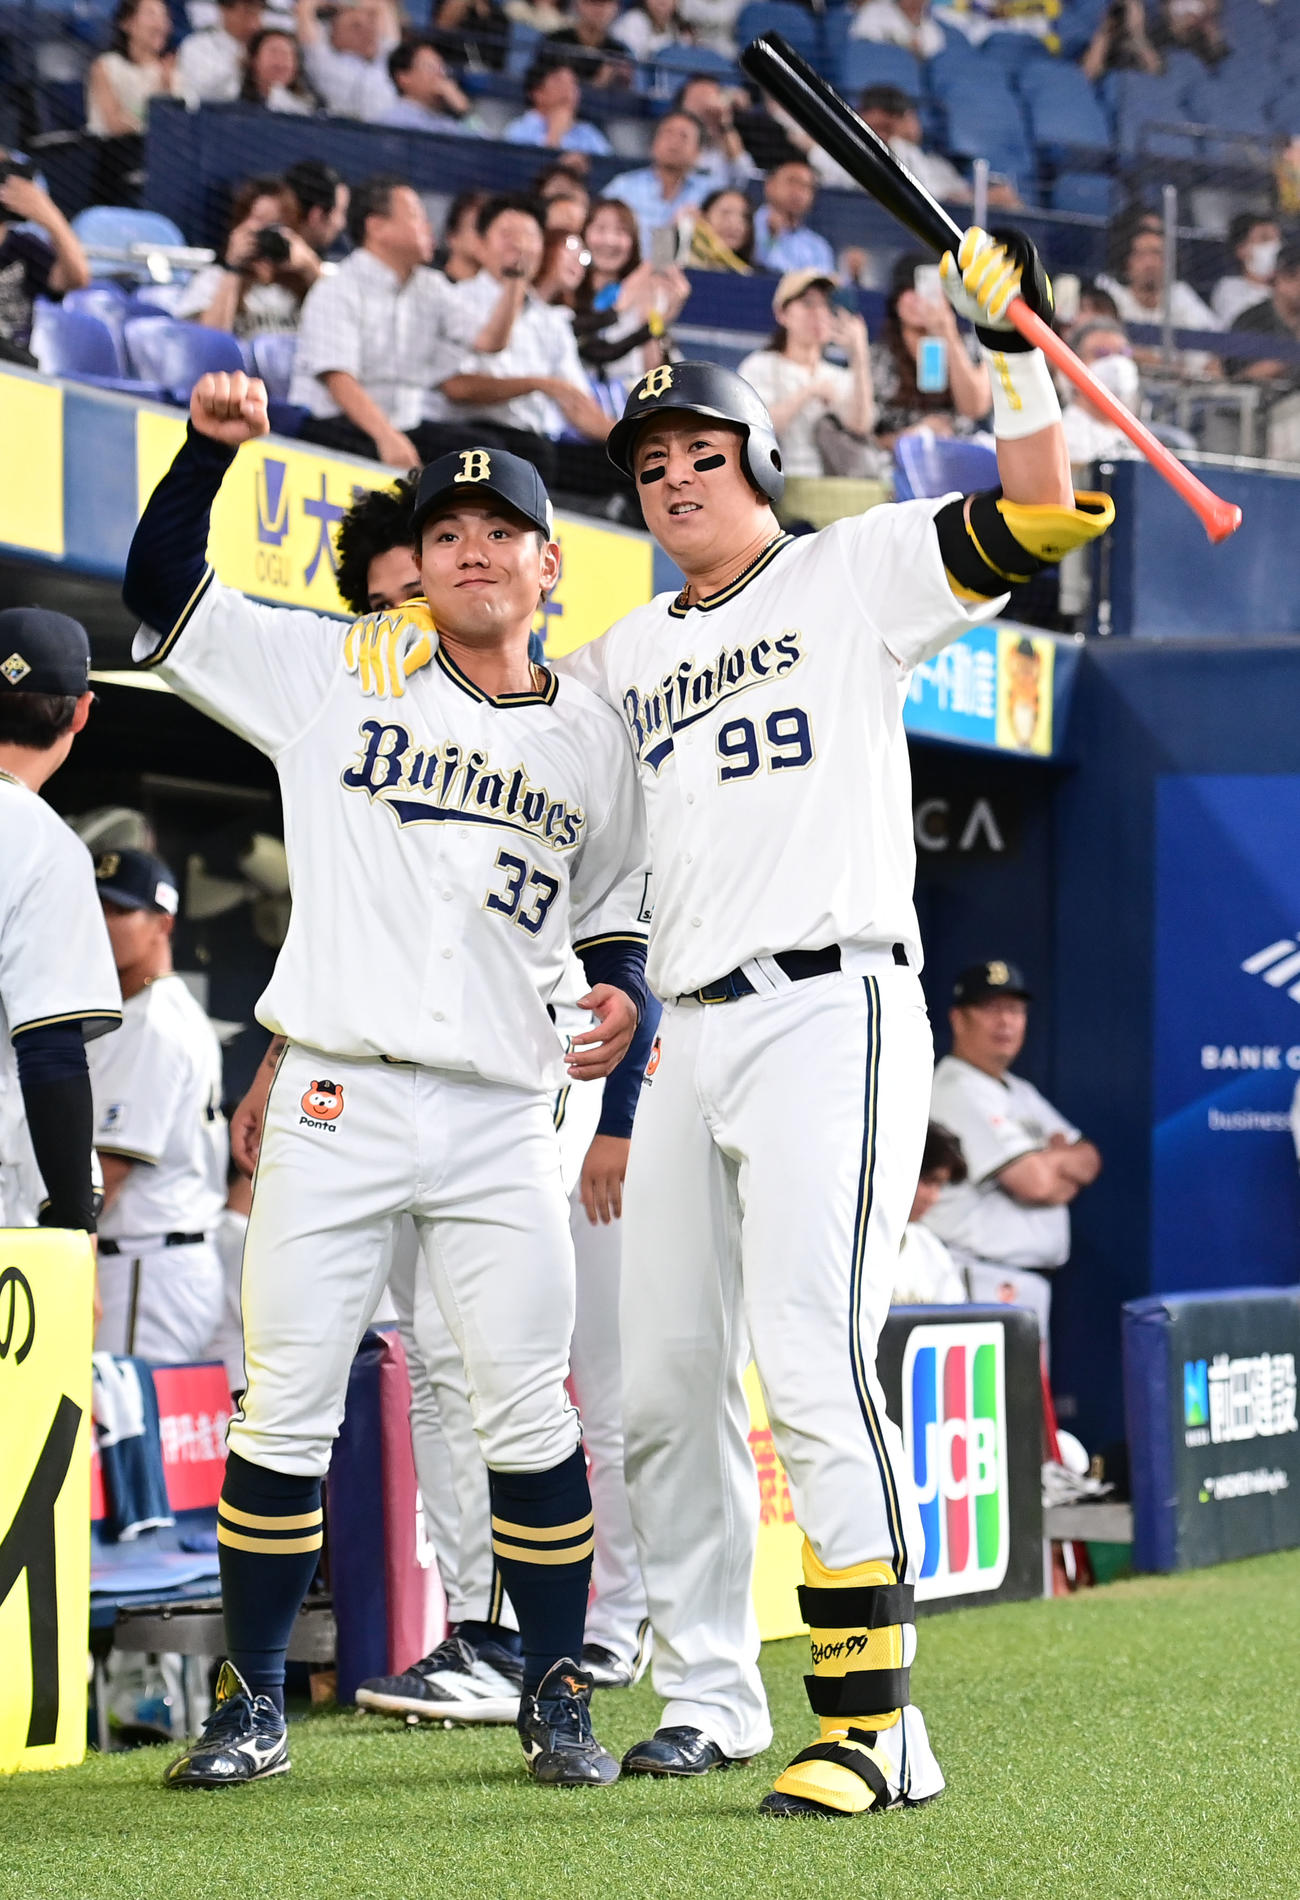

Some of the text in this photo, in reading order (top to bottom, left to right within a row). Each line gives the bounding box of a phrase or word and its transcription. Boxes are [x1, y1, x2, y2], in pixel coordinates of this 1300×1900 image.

[638, 364, 673, 400] B
[453, 449, 491, 483] B
[716, 704, 817, 786] 99
[340, 716, 586, 852] Buffaloes
[482, 846, 561, 938] 33
[1201, 1044, 1282, 1070] BANK
[299, 1116, 337, 1133] Ponta
[907, 1416, 998, 1506] JCB
